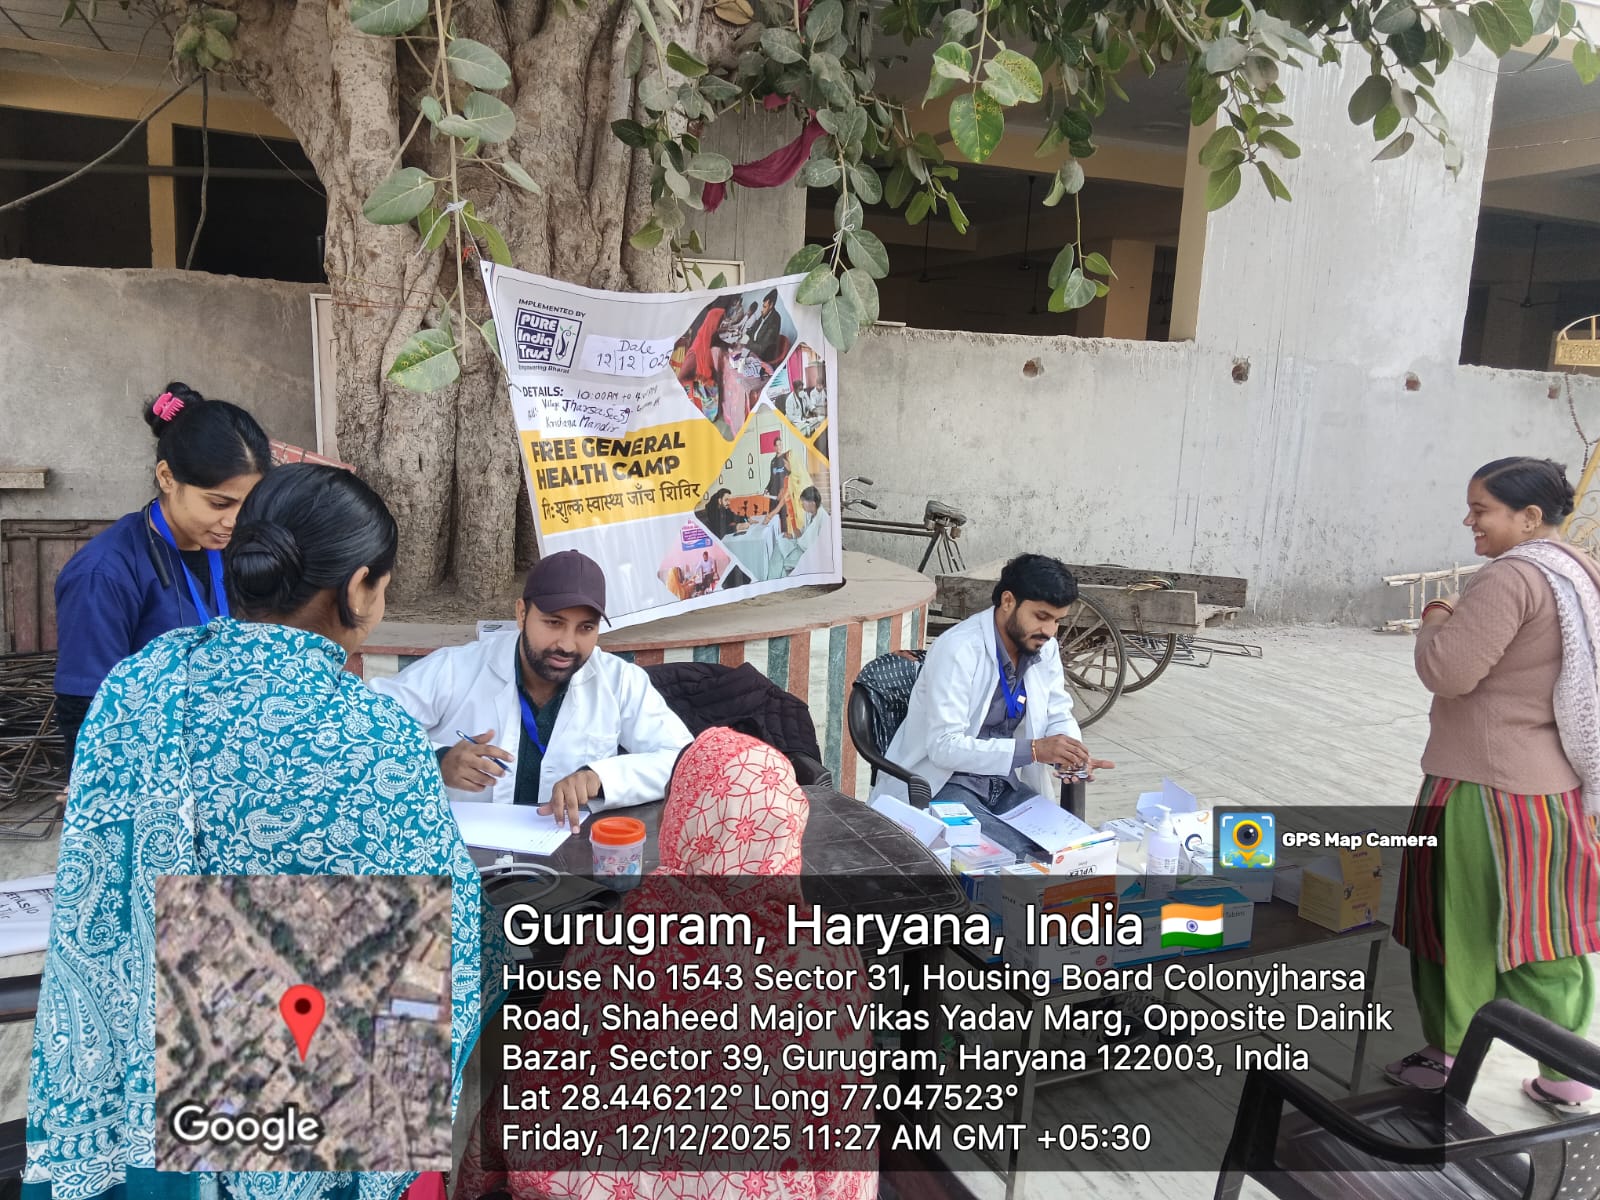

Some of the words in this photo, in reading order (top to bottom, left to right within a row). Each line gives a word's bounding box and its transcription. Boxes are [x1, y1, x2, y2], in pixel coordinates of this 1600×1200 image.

[518, 298, 574, 315] IMPLEMENTED
[520, 314, 558, 331] PURE
[518, 329, 553, 346] India
[518, 344, 550, 360] Trust
[522, 386, 564, 397] DETAILS:
[531, 438, 578, 463] FREE
[581, 432, 686, 458] GENERAL
[536, 463, 608, 490] HEALTH
[612, 455, 681, 481] CAMP
[586, 492, 624, 513] स्वास्थ्य
[659, 479, 701, 502] शिविर
